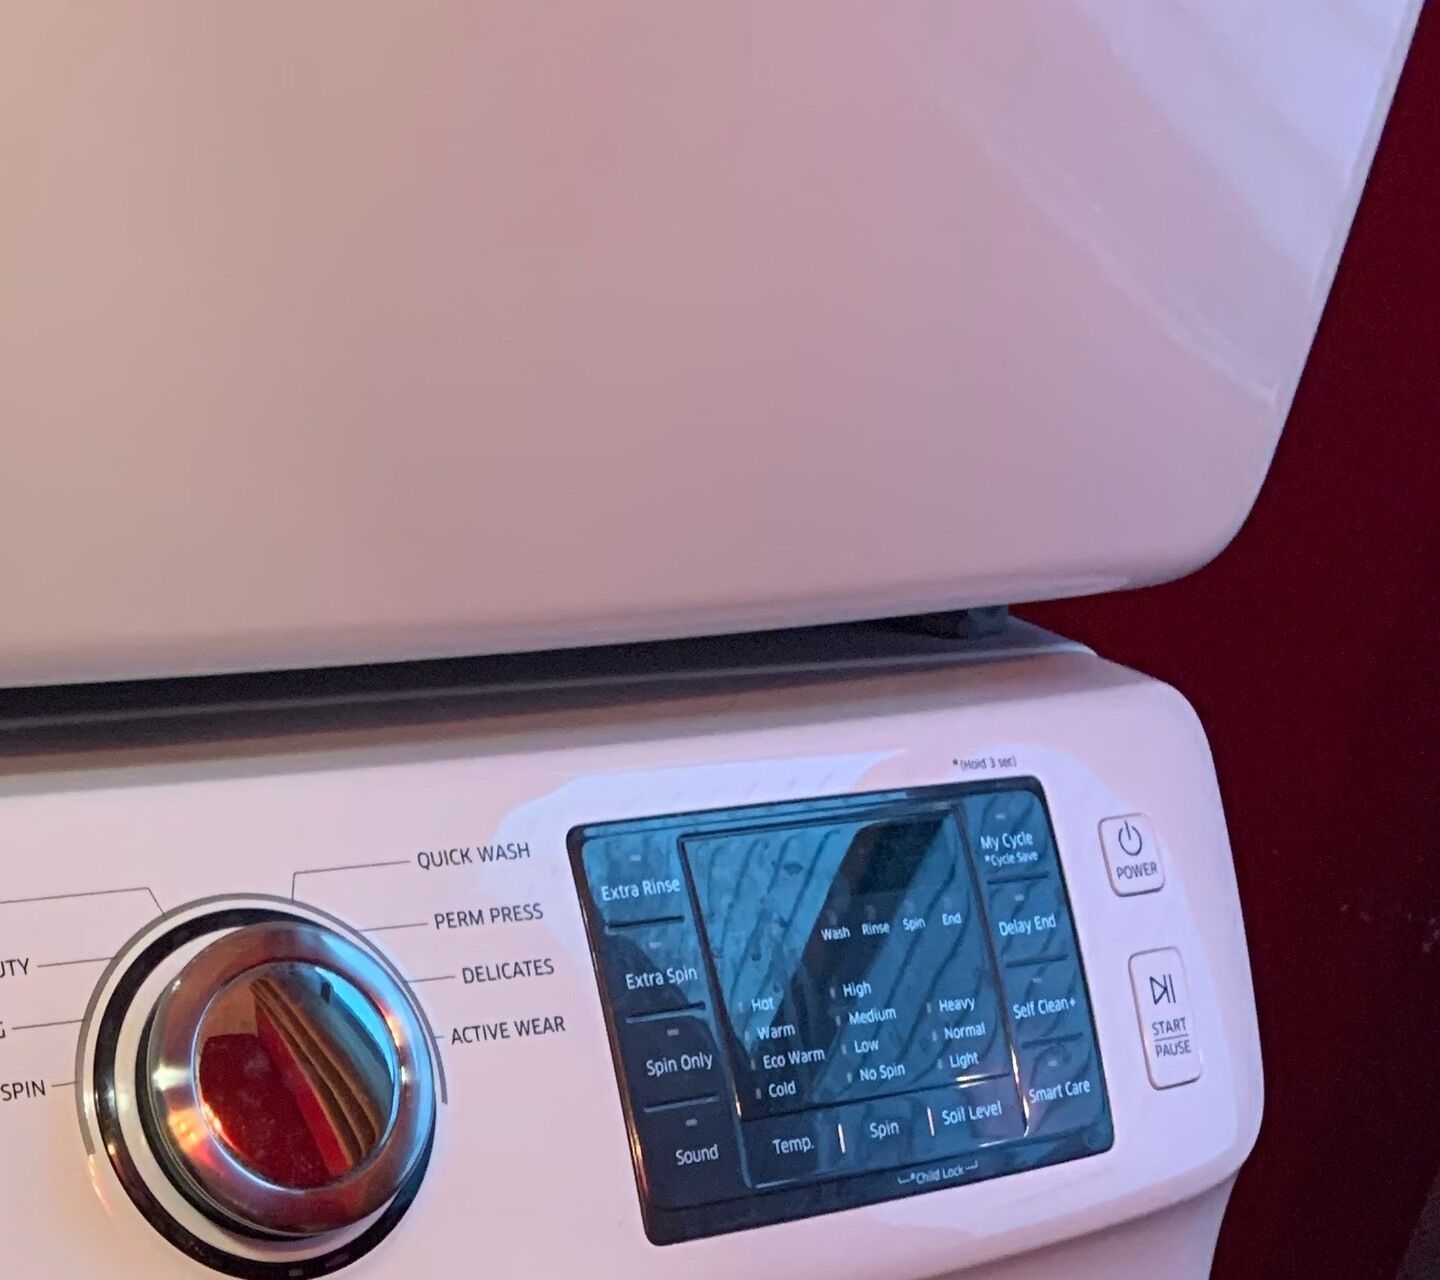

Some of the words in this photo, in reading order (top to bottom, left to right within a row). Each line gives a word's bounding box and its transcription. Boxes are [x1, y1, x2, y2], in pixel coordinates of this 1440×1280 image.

[981, 834, 999, 851] My
[1002, 832, 1033, 849] Cycle
[417, 847, 473, 870] QUICK
[478, 842, 531, 863] WASH
[1016, 850, 1038, 863] Save
[1116, 862, 1158, 880] POWER
[601, 881, 639, 902] Extra
[642, 877, 681, 896] Rinse
[434, 909, 484, 931] PERM
[489, 903, 545, 926] PRESS
[821, 927, 850, 941] Wash
[861, 922, 890, 936] Rinse
[903, 917, 926, 933] Spin
[942, 912, 962, 926] End
[998, 919, 1032, 937] Delay
[1034, 913, 1057, 931] End
[462, 958, 555, 985] DELICATES
[625, 971, 663, 990] Extra
[666, 965, 698, 985] Spin
[843, 981, 872, 999] High
[751, 996, 775, 1012] Hot
[939, 997, 975, 1013] Heavy
[1013, 1002, 1036, 1020] Self
[848, 1006, 896, 1026] Medium
[1152, 1016, 1187, 1036] START
[451, 1020, 510, 1046] ACTIVE
[514, 1016, 567, 1039] WEAR
[757, 1024, 796, 1041] Warm
[944, 1022, 986, 1041] Normal
[854, 1040, 879, 1054] Low
[1155, 1039, 1192, 1058] PAUSE
[646, 1057, 678, 1078] Spin
[680, 1051, 713, 1072] Only
[763, 1054, 786, 1070] Eco
[787, 1048, 825, 1065] Warm
[949, 1051, 979, 1069] Light
[860, 1067, 877, 1082] No
[879, 1062, 905, 1080] Spin
[768, 1081, 796, 1098] Cold
[1029, 1083, 1064, 1104] Smart
[1065, 1078, 1091, 1097] Care
[942, 1106, 966, 1126] Soil
[968, 1100, 1003, 1121] Level
[869, 1120, 900, 1139] Spin
[676, 1144, 719, 1166] Sound
[772, 1135, 815, 1156] Temp.
[942, 1164, 965, 1179] Lock
